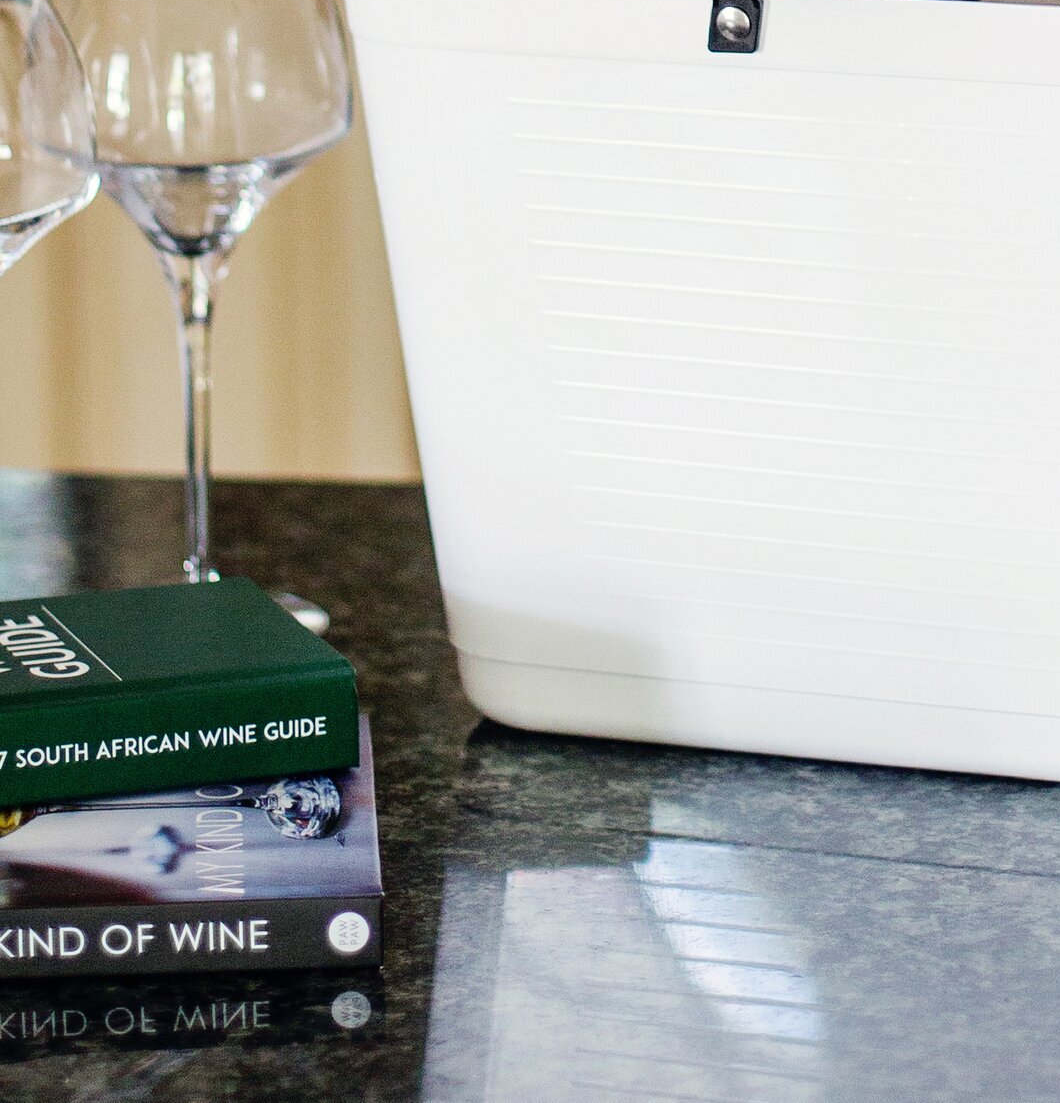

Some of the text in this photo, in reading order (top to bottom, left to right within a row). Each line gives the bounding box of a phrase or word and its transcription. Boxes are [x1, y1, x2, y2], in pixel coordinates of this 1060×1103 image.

[0, 615, 90, 679] GUIDE
[15, 742, 89, 769] SOUTH
[96, 731, 190, 760] AFRICAN
[198, 723, 257, 748] WINE
[263, 716, 327, 741] GUIDE
[196, 808, 244, 854] KIND
[196, 861, 245, 895] MY
[0, 919, 269, 958] KIND OF WINE
